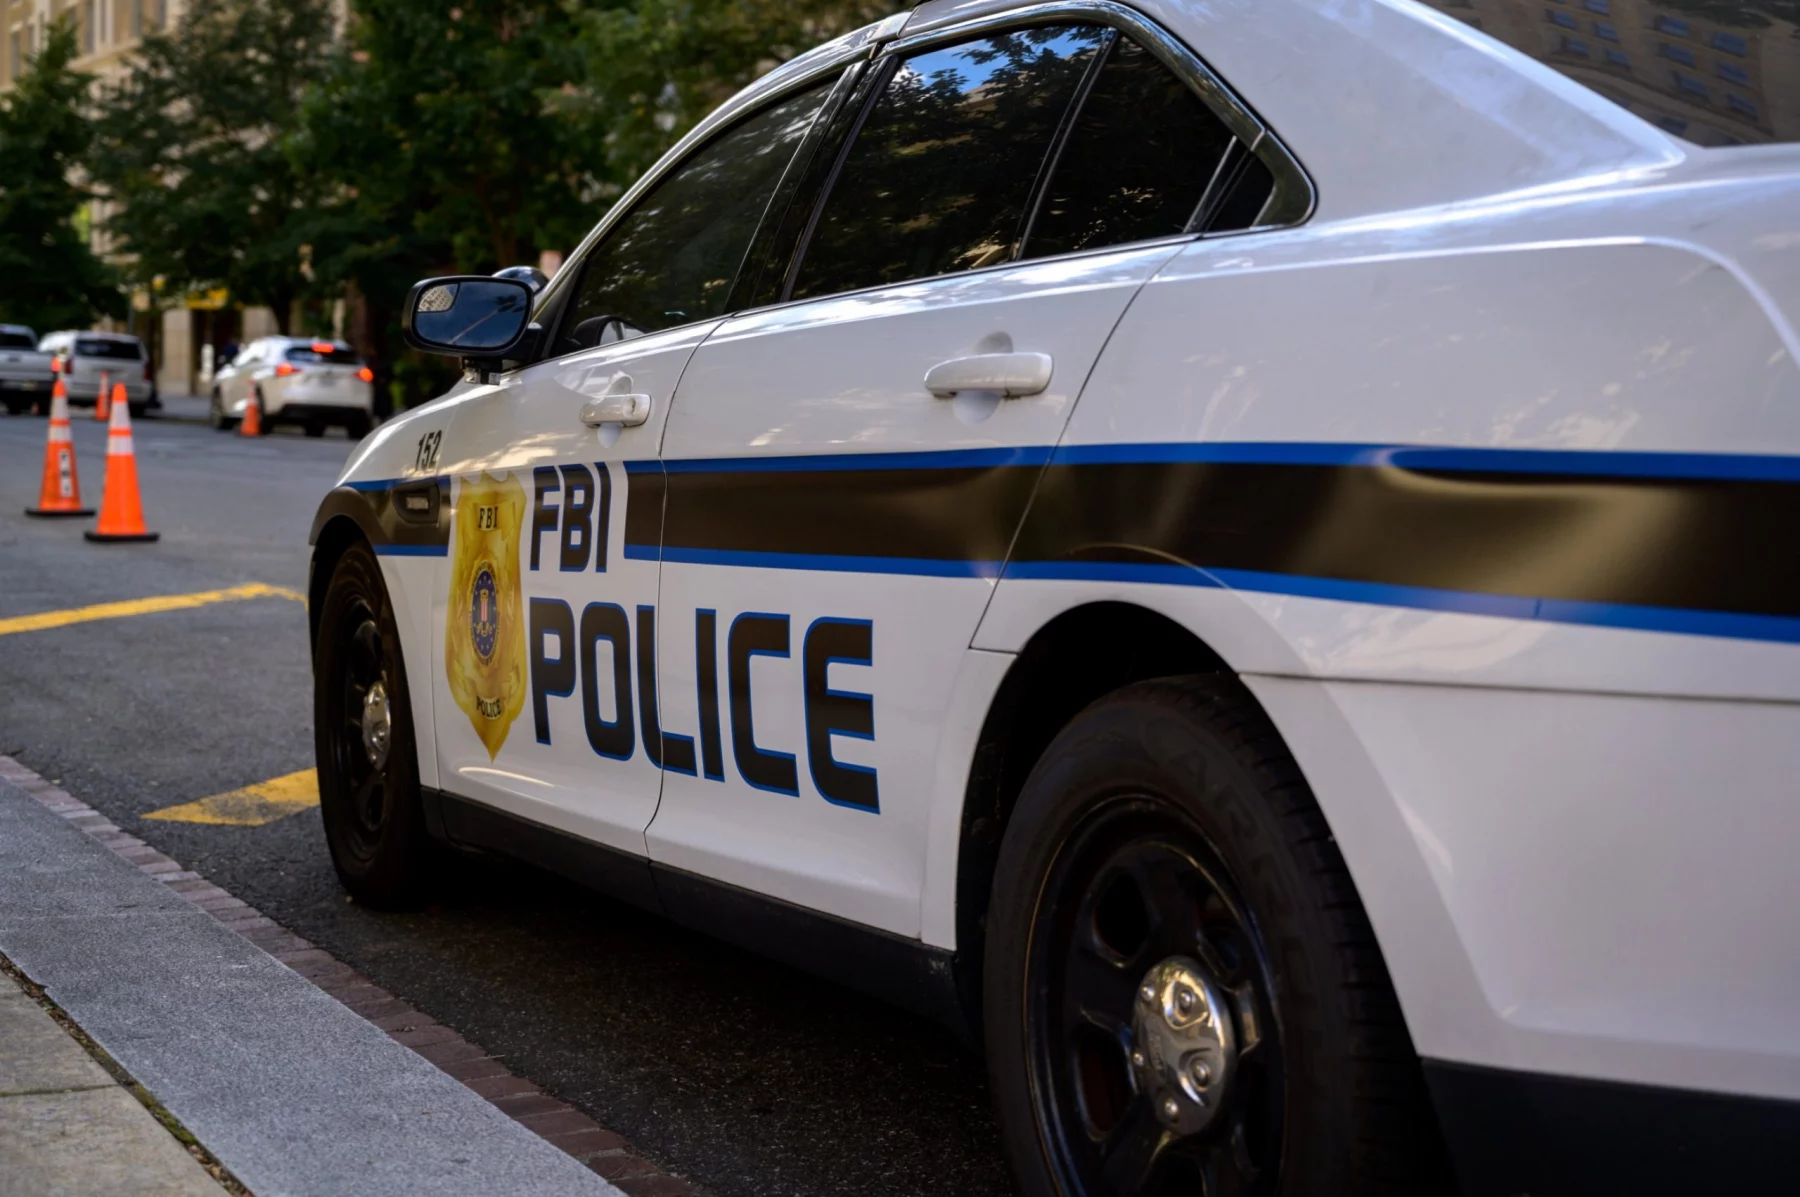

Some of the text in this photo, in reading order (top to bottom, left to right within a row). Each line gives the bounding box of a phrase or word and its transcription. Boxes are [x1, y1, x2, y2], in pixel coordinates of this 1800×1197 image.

[415, 430, 443, 471] 152
[478, 506, 499, 529] FBI
[530, 461, 612, 573] FBI
[476, 695, 502, 718] POLICE
[529, 597, 881, 815] POLICE
